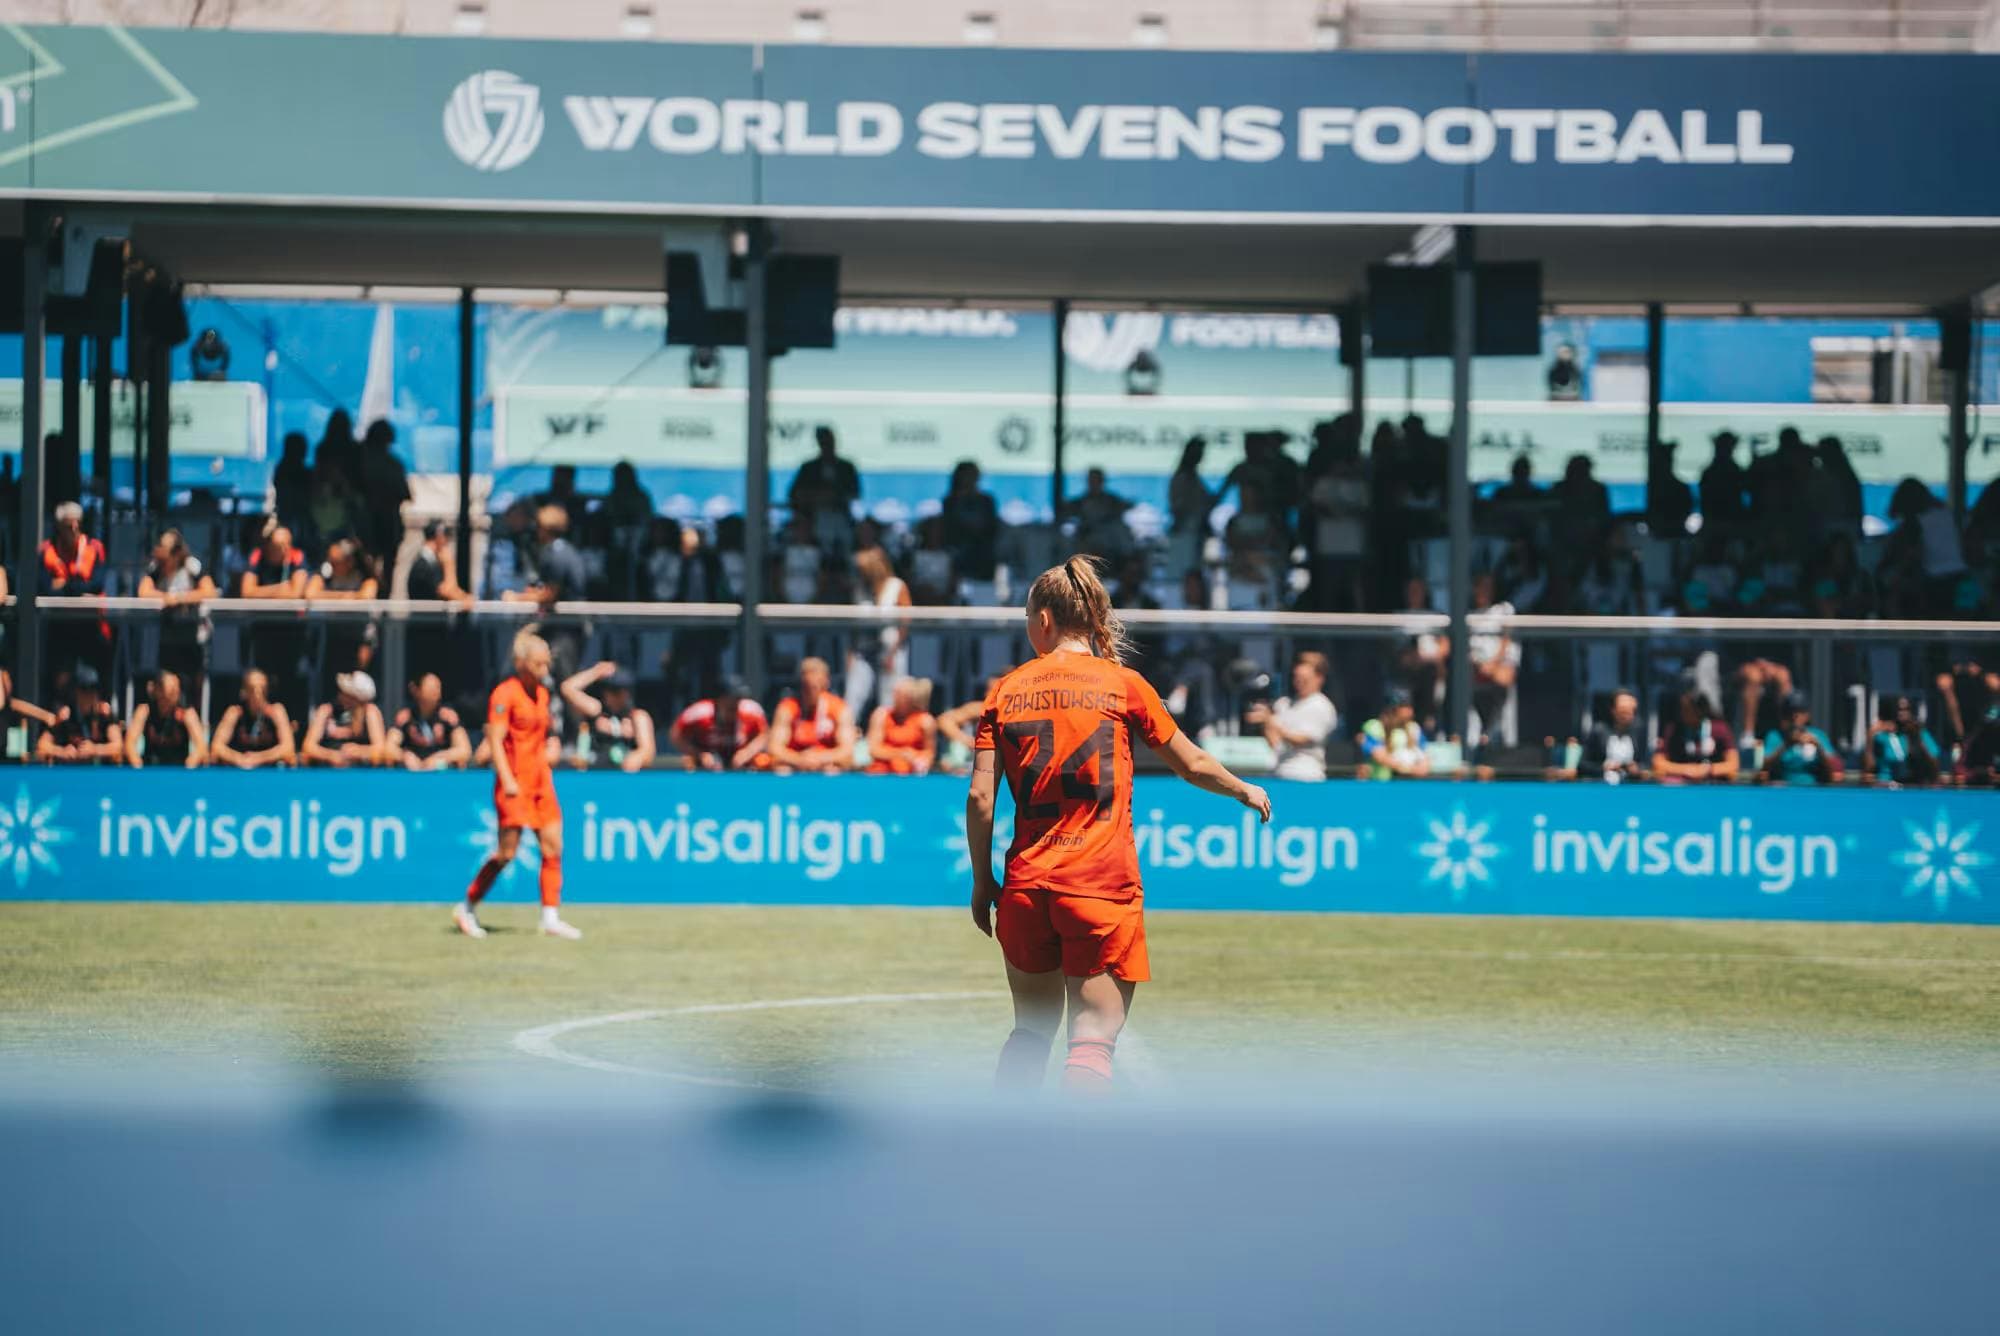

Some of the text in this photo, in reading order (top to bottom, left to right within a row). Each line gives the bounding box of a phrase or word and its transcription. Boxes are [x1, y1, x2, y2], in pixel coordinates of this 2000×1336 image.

[562, 95, 1795, 164] WORLD SEVENS FOOTBALL
[1003, 718, 1115, 821] 24
[99, 797, 408, 877] invisalign
[583, 801, 886, 881] invisalign
[1134, 808, 1359, 887] isalign
[1532, 813, 1839, 893] invisalign
